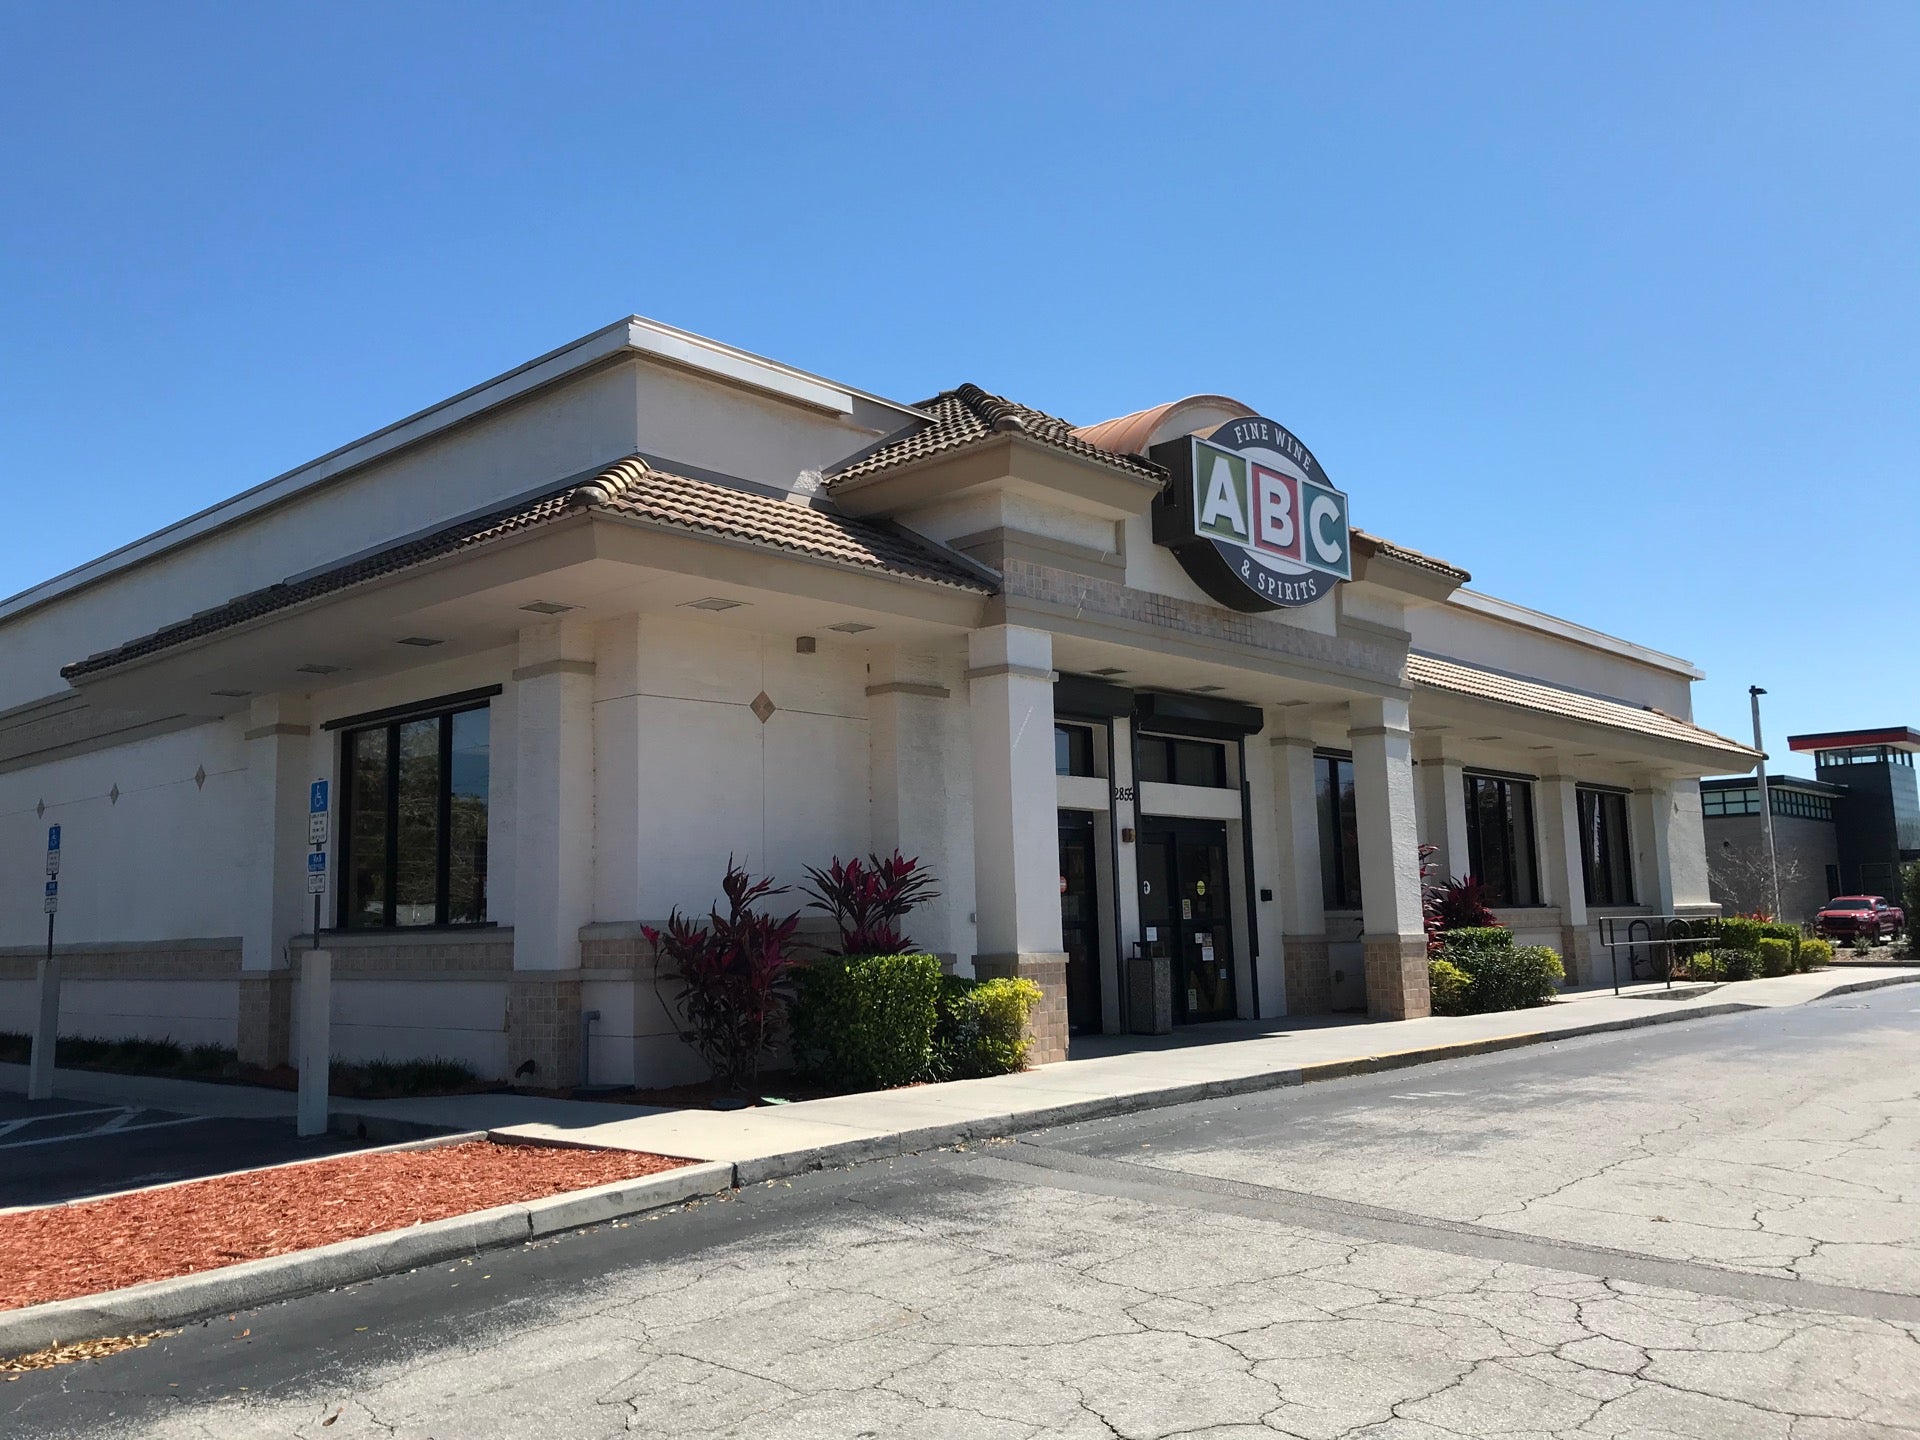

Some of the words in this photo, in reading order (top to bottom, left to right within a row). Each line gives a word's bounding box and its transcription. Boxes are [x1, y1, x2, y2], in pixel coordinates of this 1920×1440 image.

[1234, 422, 1269, 444] FINE
[1274, 427, 1312, 472] WINE
[1201, 455, 1343, 564] ABC
[1241, 559, 1250, 579] &
[1257, 572, 1317, 601] SPIRITS
[1114, 787, 1134, 801] 2855
